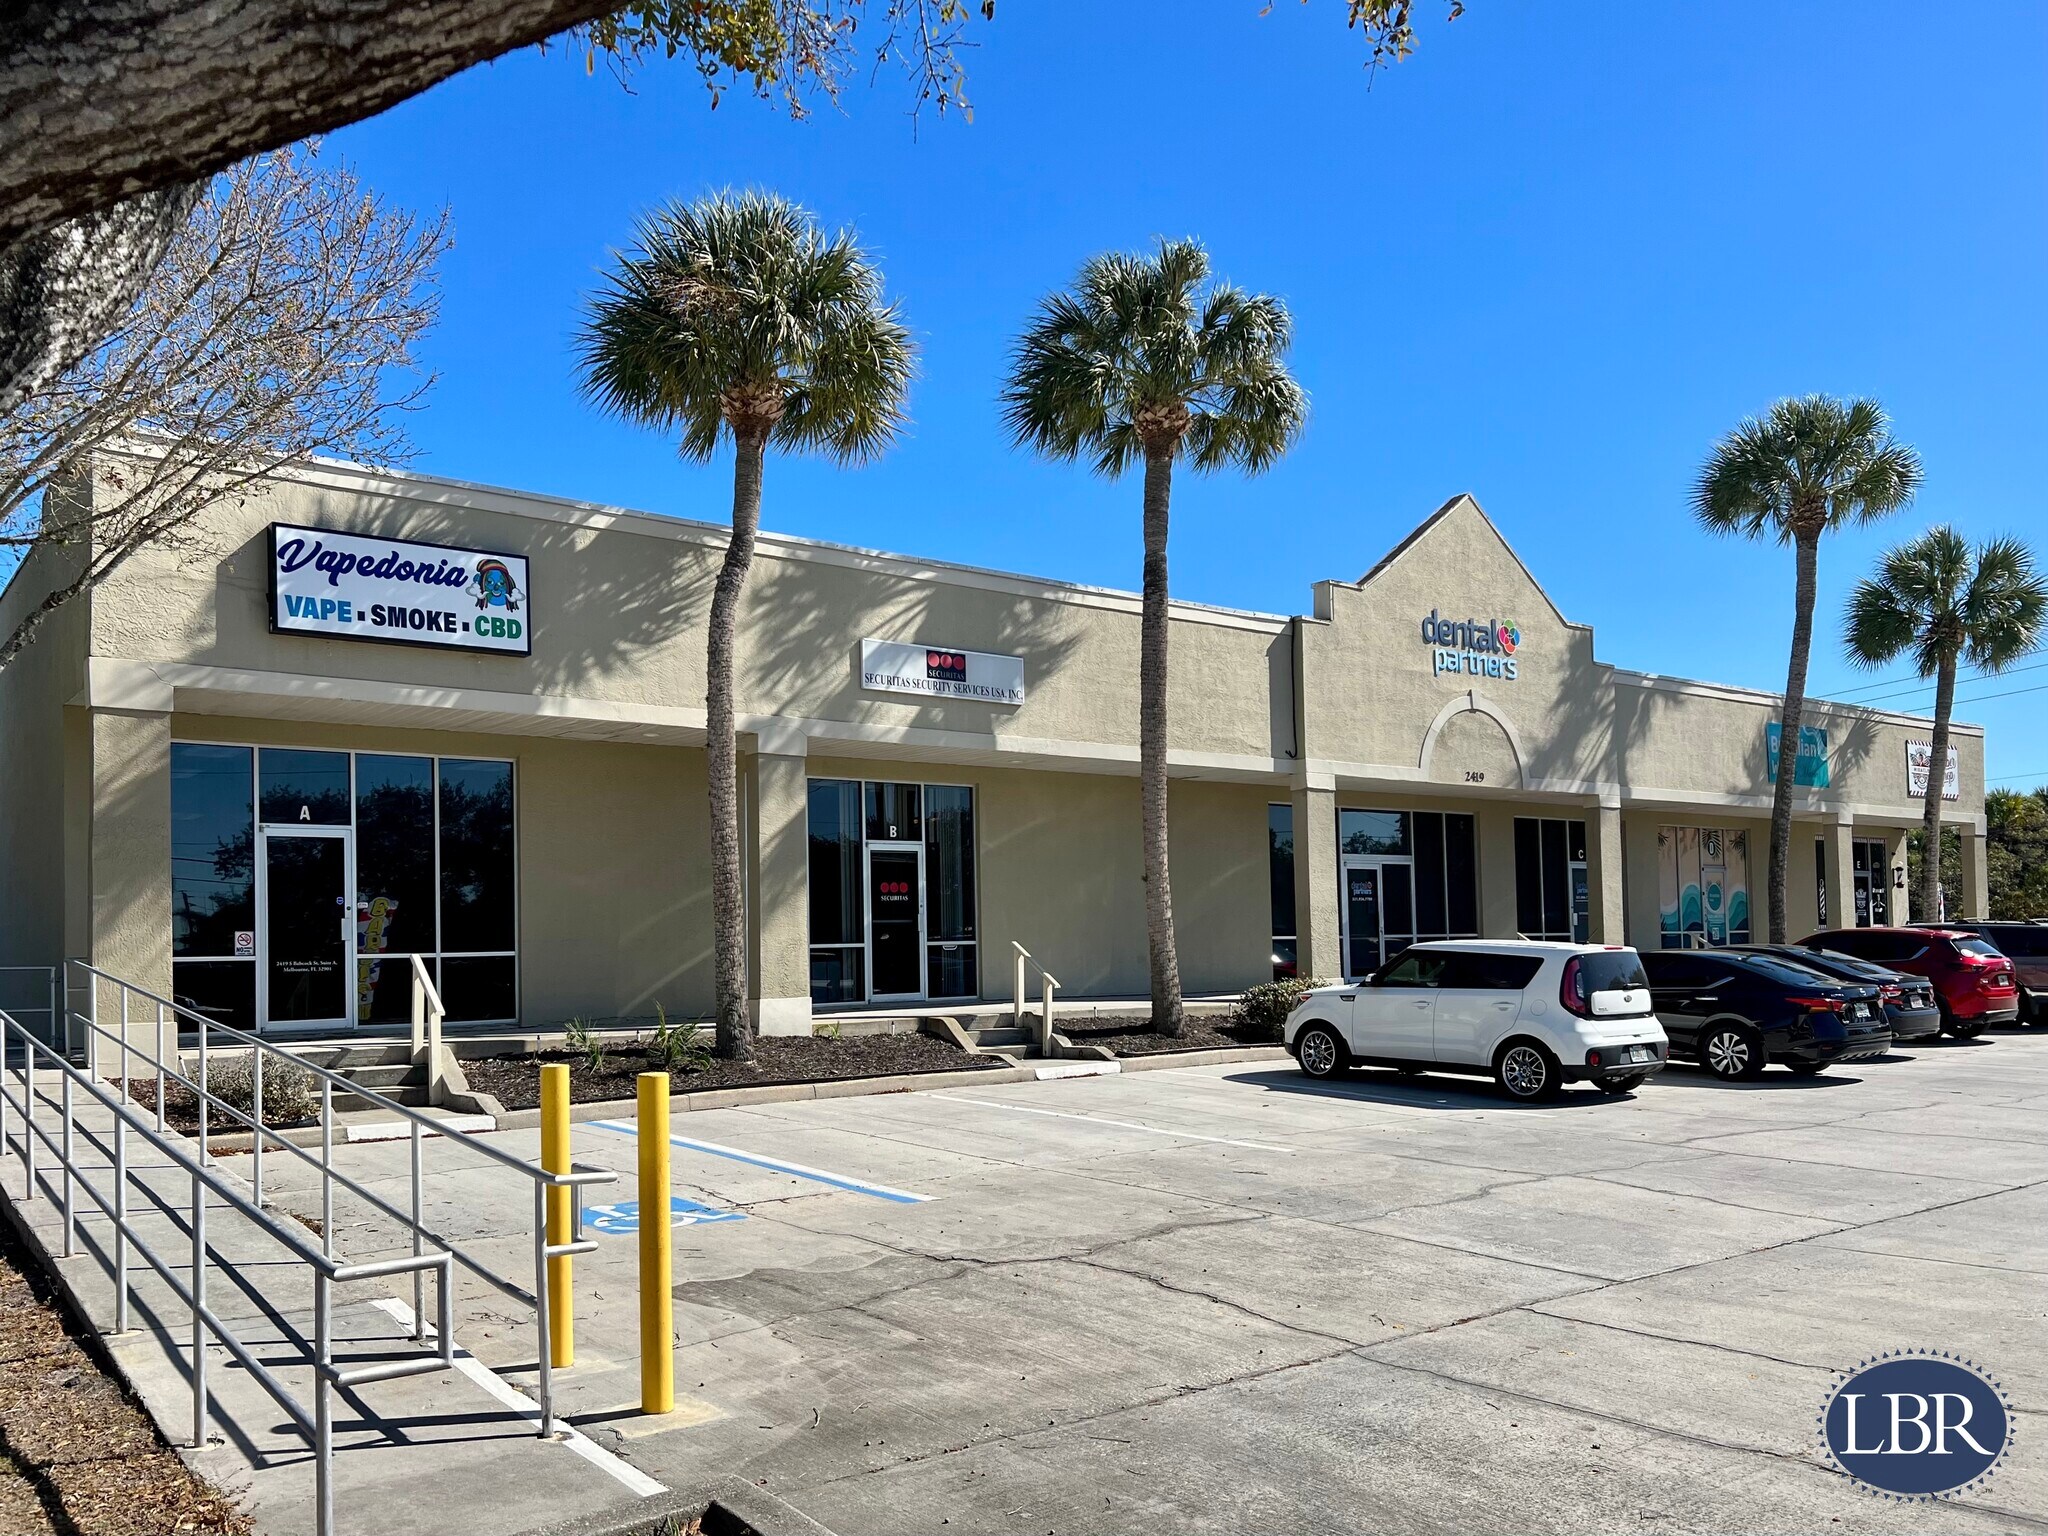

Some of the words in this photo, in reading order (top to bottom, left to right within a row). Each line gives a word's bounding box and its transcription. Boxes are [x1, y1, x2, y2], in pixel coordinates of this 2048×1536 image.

[277, 538, 469, 587] Vapedonia
[284, 594, 352, 623] VAPE
[371, 604, 457, 633] SMOKE
[475, 615, 522, 639] CBD
[1422, 608, 1500, 652] dental
[928, 669, 965, 681] SECURITAS
[1434, 648, 1518, 680] partners
[864, 672, 911, 688] SECURITAS
[912, 678, 953, 693] SECURITY
[953, 683, 990, 696] SERVICES
[1008, 689, 1023, 700] INC.
[1465, 771, 1484, 783] 2419
[299, 805, 311, 821] A
[889, 825, 897, 838] B
[1578, 849, 1584, 859] C
